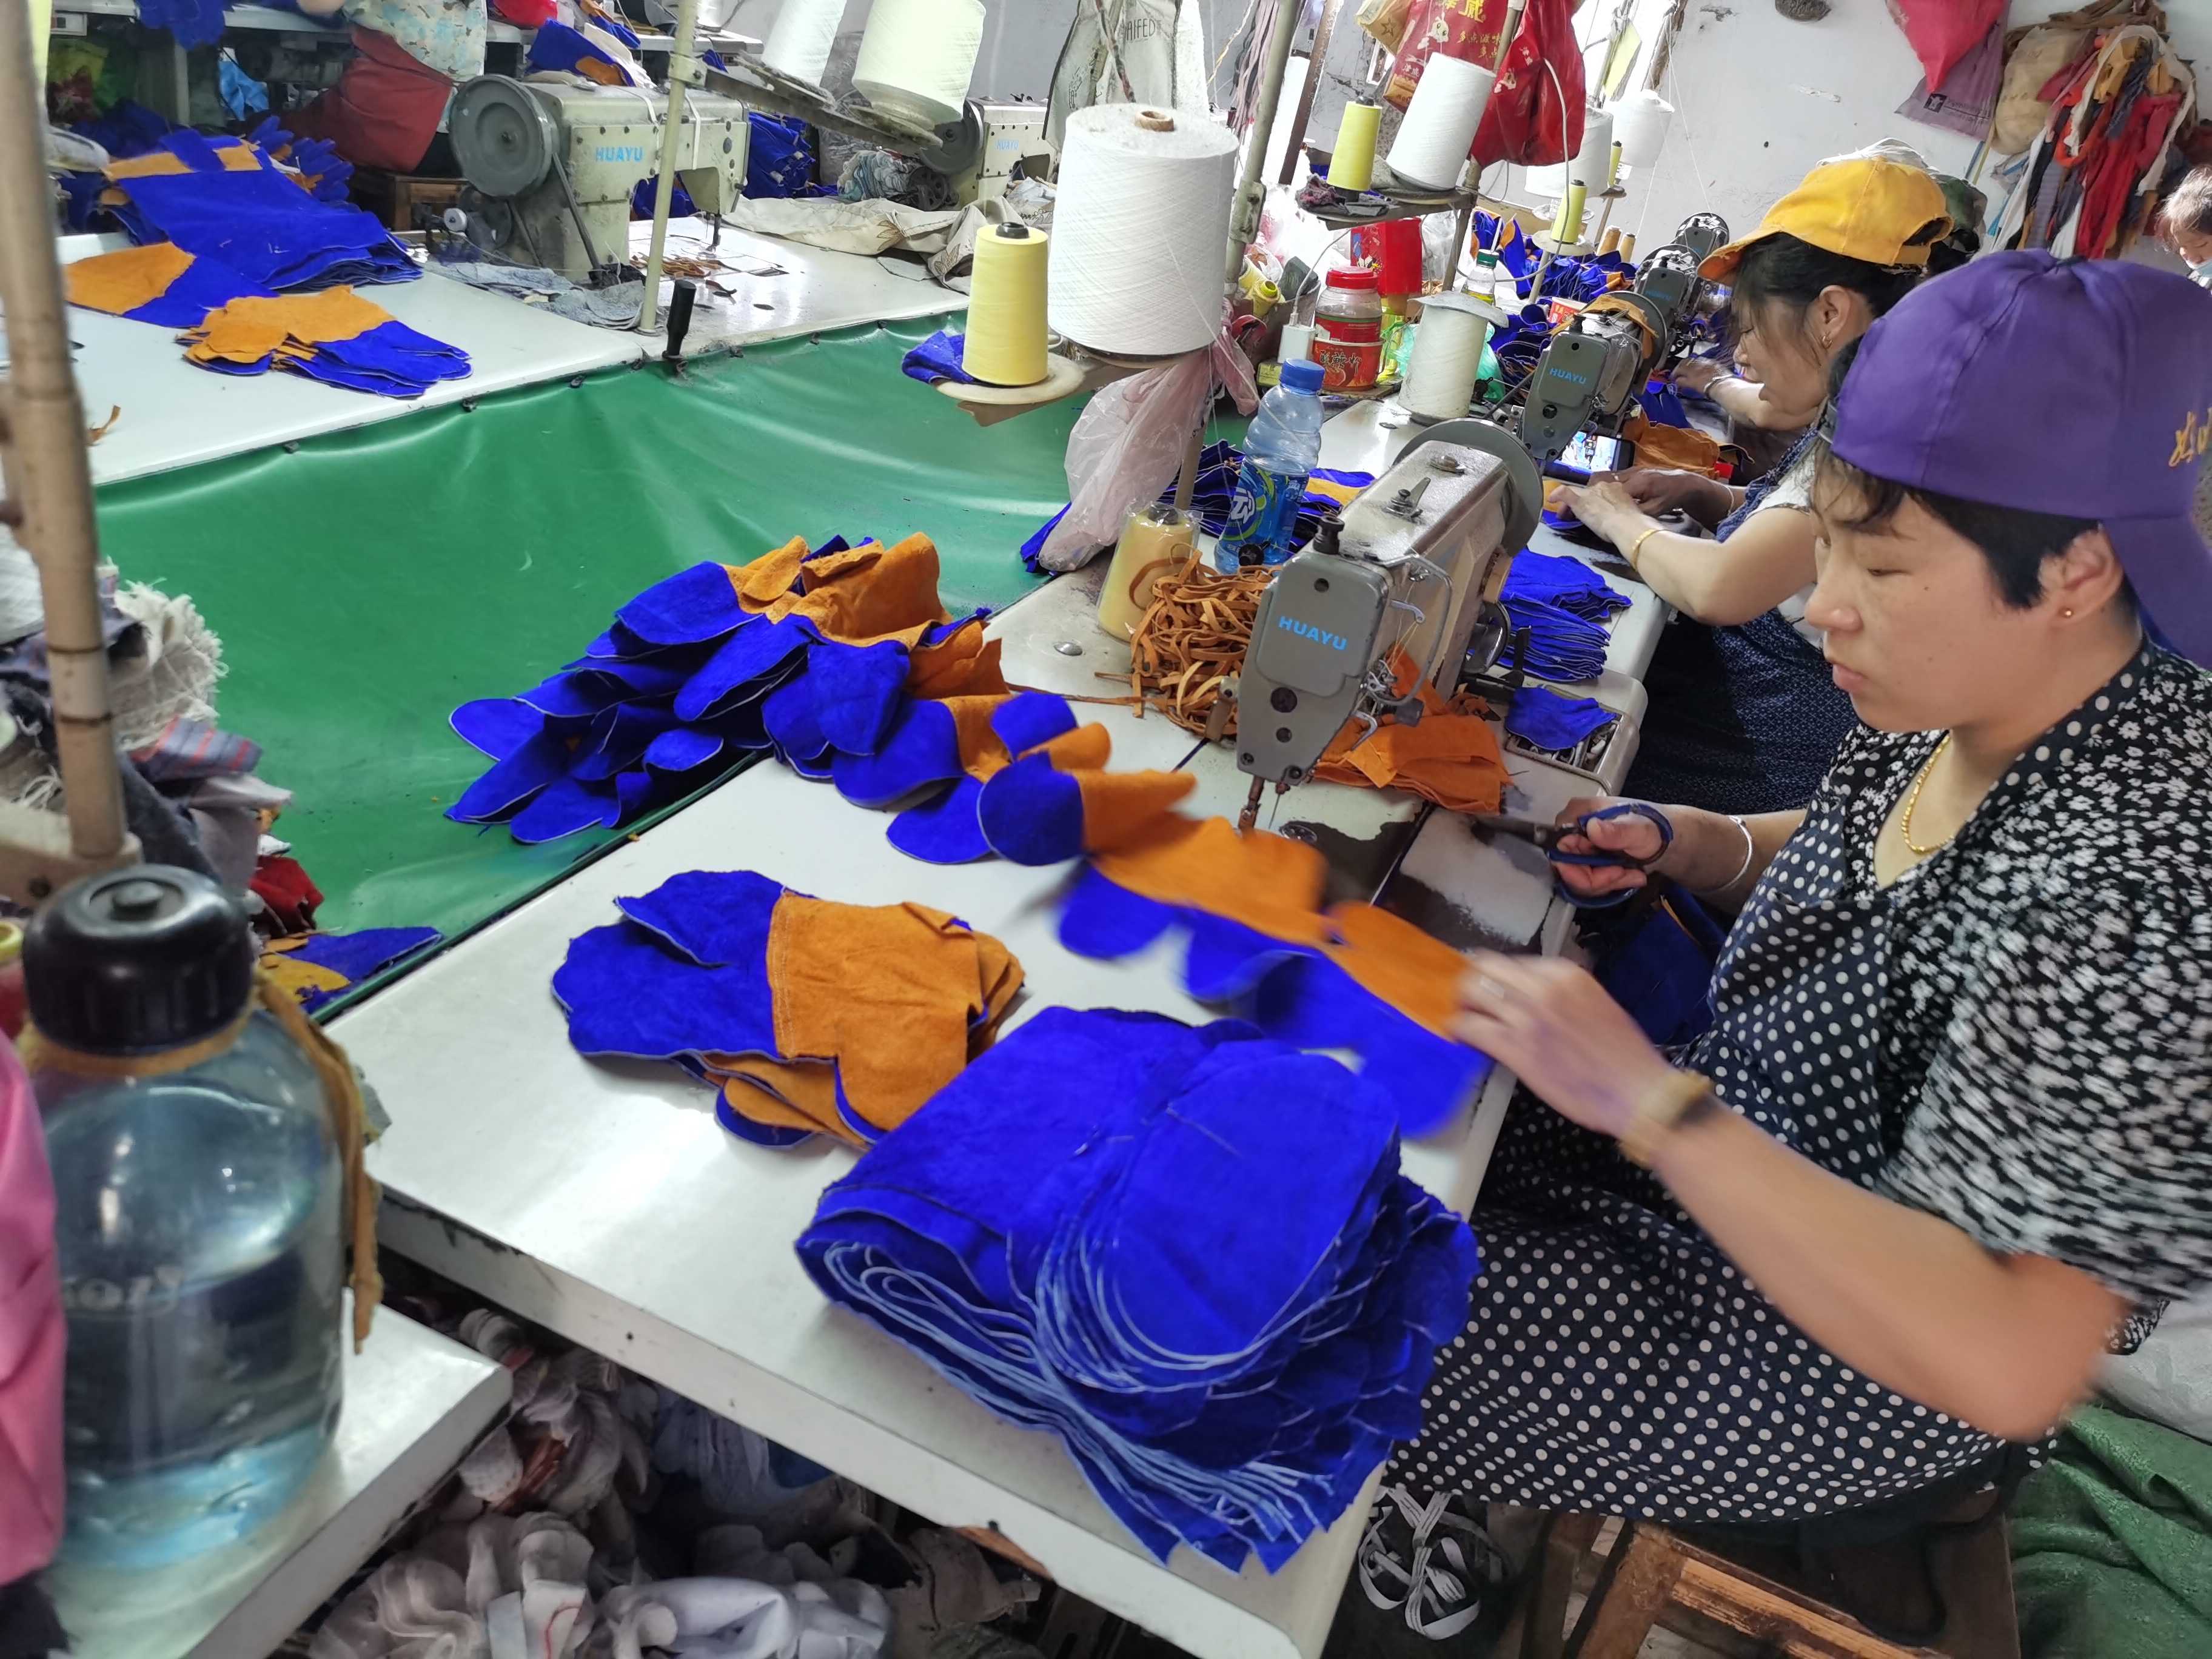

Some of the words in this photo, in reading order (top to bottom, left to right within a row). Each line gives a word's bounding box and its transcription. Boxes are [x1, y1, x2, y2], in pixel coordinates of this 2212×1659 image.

[595, 147, 643, 162] HUAYU
[1319, 350, 1362, 377] 酸辣粉
[1549, 367, 1587, 384] HUAYU
[1278, 615, 1347, 651] HUAYU
